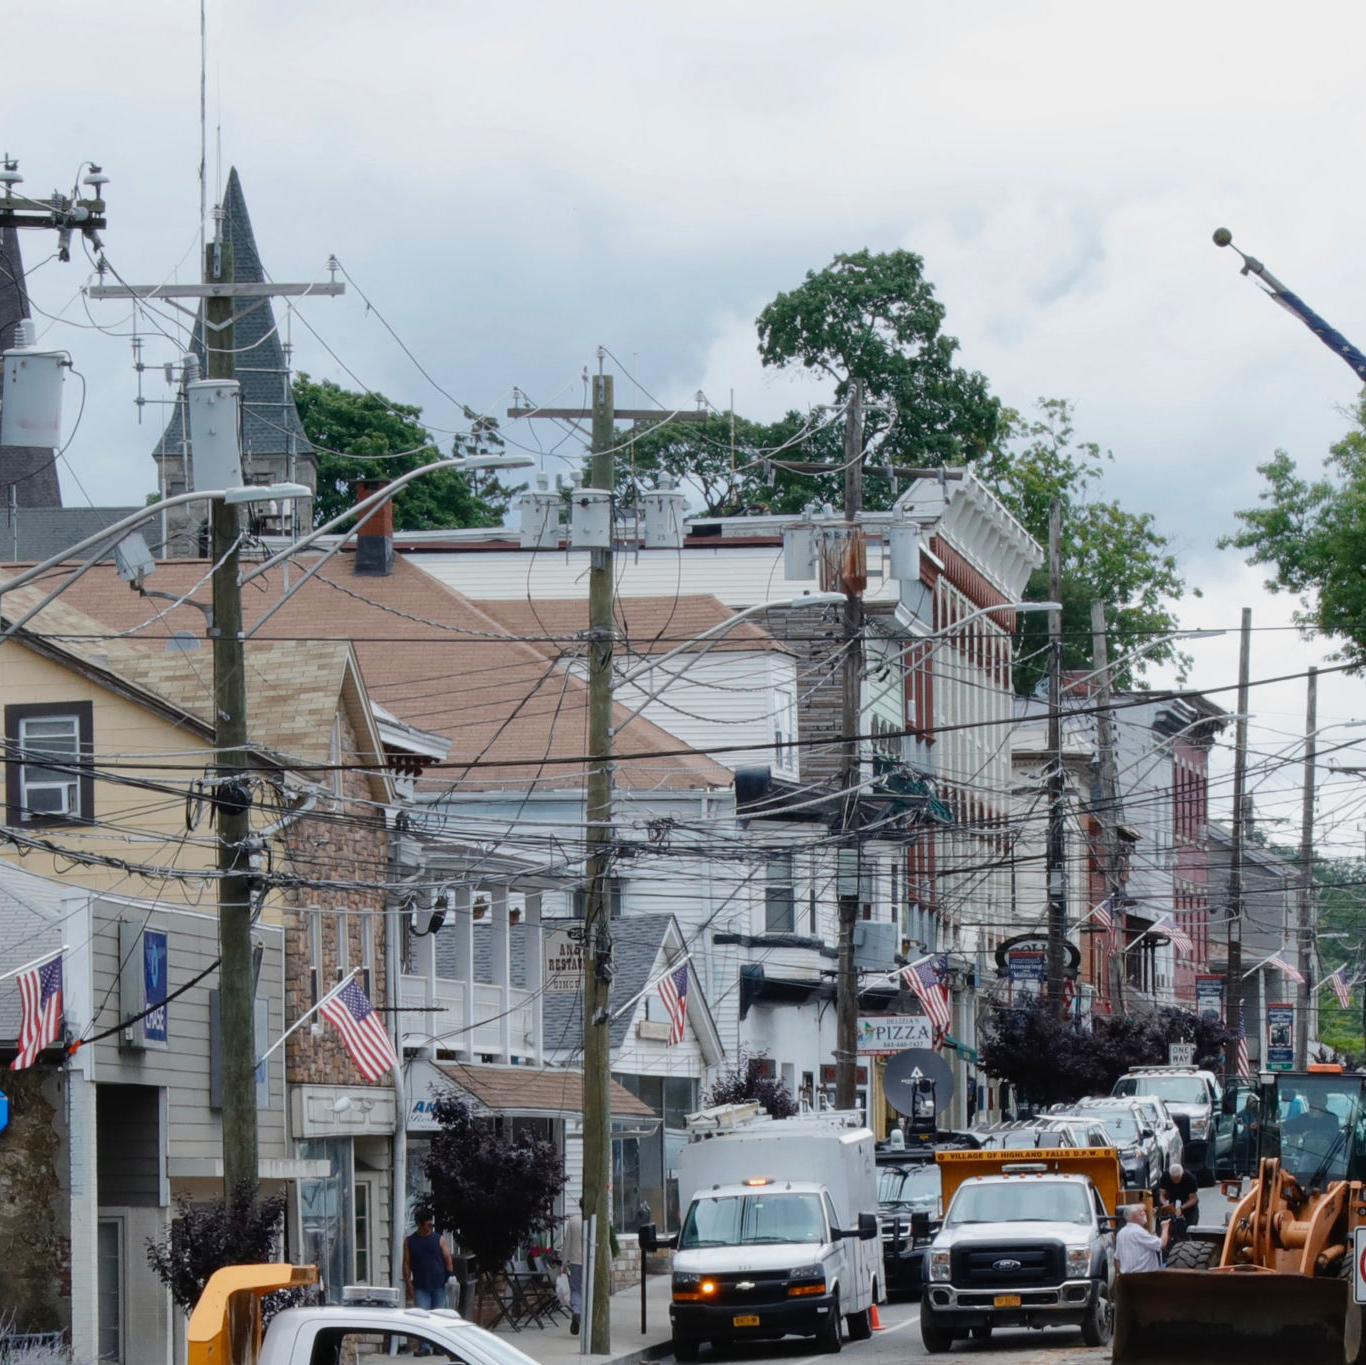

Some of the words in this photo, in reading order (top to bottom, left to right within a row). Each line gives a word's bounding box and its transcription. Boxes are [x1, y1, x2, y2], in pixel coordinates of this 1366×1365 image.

[548, 958, 585, 971] RESTAU
[145, 1003, 164, 1031] CHASE
[876, 1026, 930, 1040] PIZZA
[1172, 1046, 1189, 1054] ONE
[1172, 1055, 1189, 1063] WAY
[950, 1152, 983, 1160] VILLAGE
[1000, 1150, 1043, 1159] HIGHLAND
[1045, 1150, 1070, 1158] FALLS
